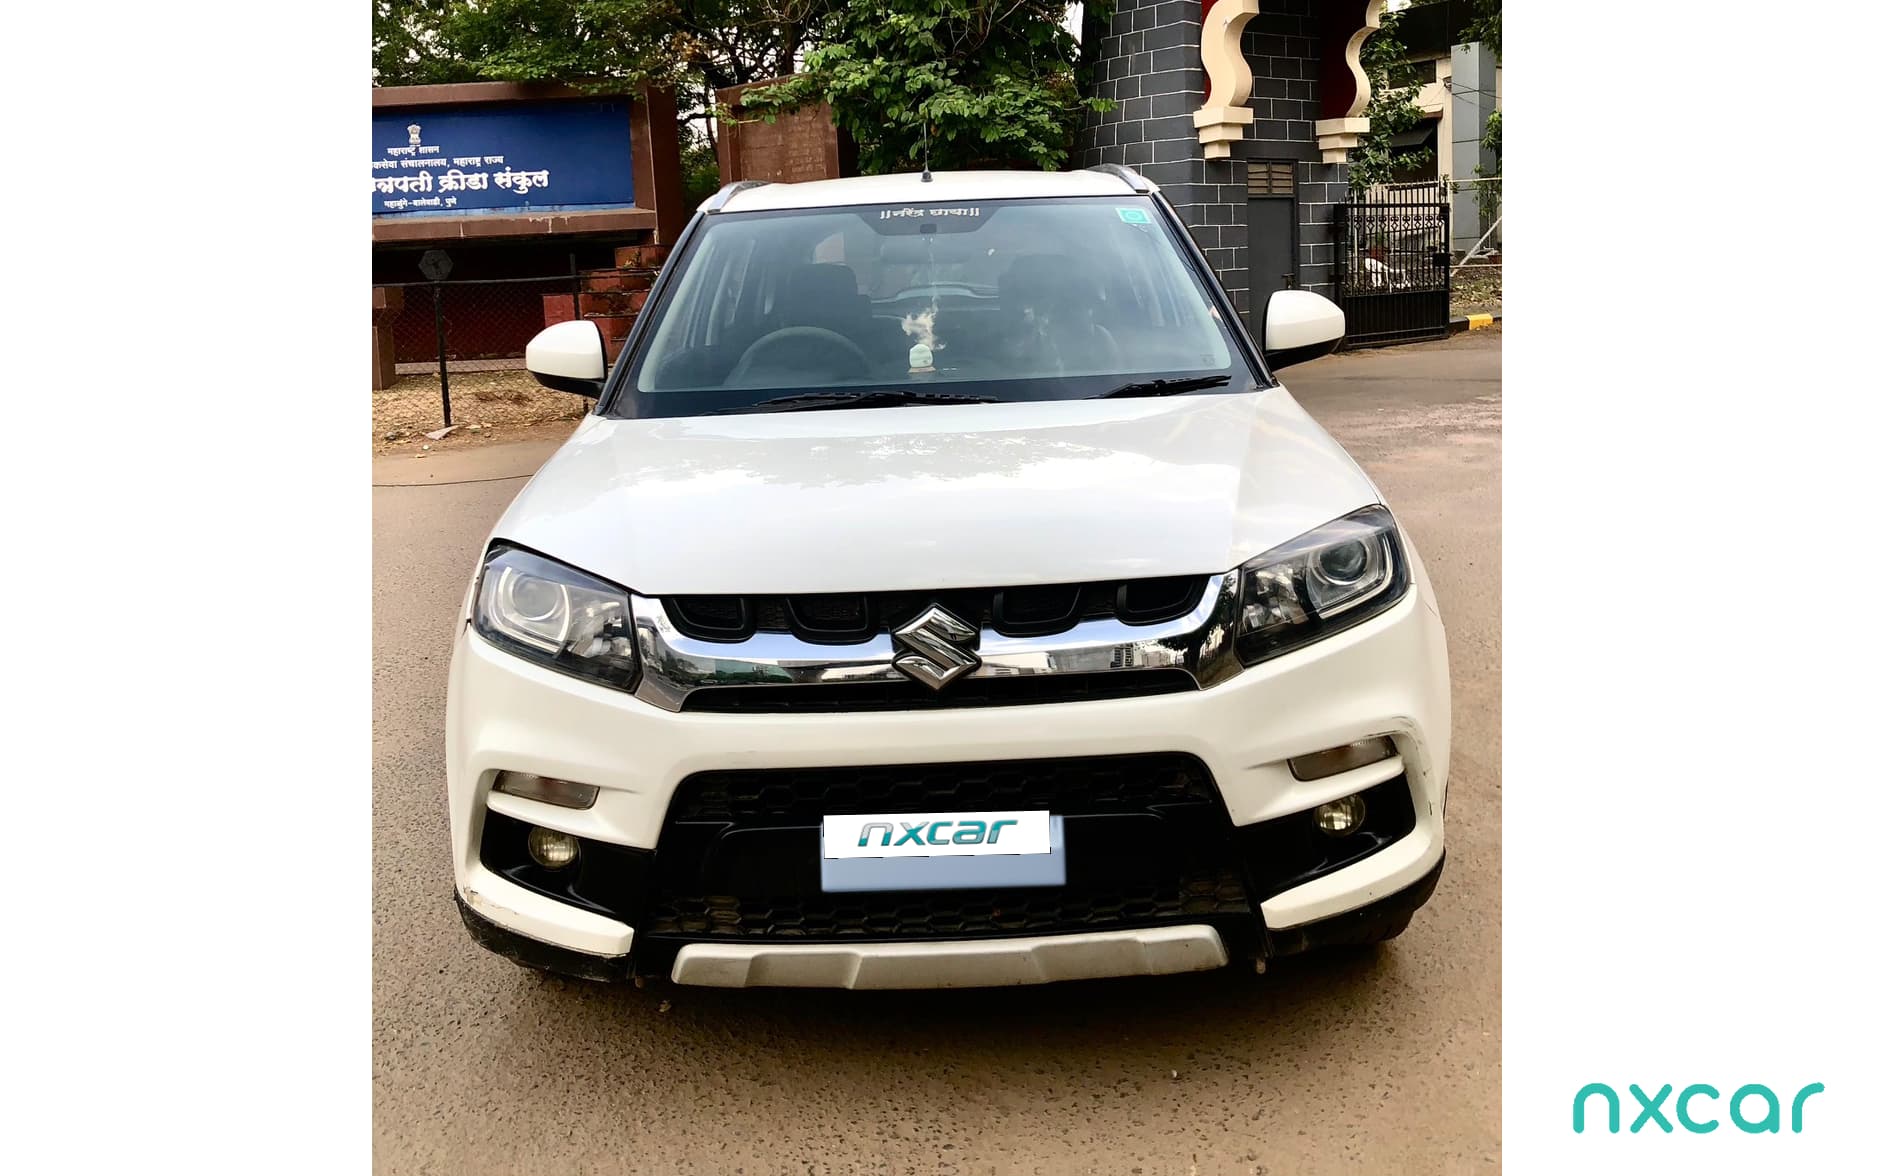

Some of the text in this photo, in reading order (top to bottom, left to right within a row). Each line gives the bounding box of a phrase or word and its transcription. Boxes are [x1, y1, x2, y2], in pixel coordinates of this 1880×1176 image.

[419, 146, 440, 154] शासन
[372, 158, 398, 169] कसेवा
[483, 155, 504, 165] राज्य
[438, 169, 488, 193] क्रीडा
[493, 166, 549, 194] संकुल
